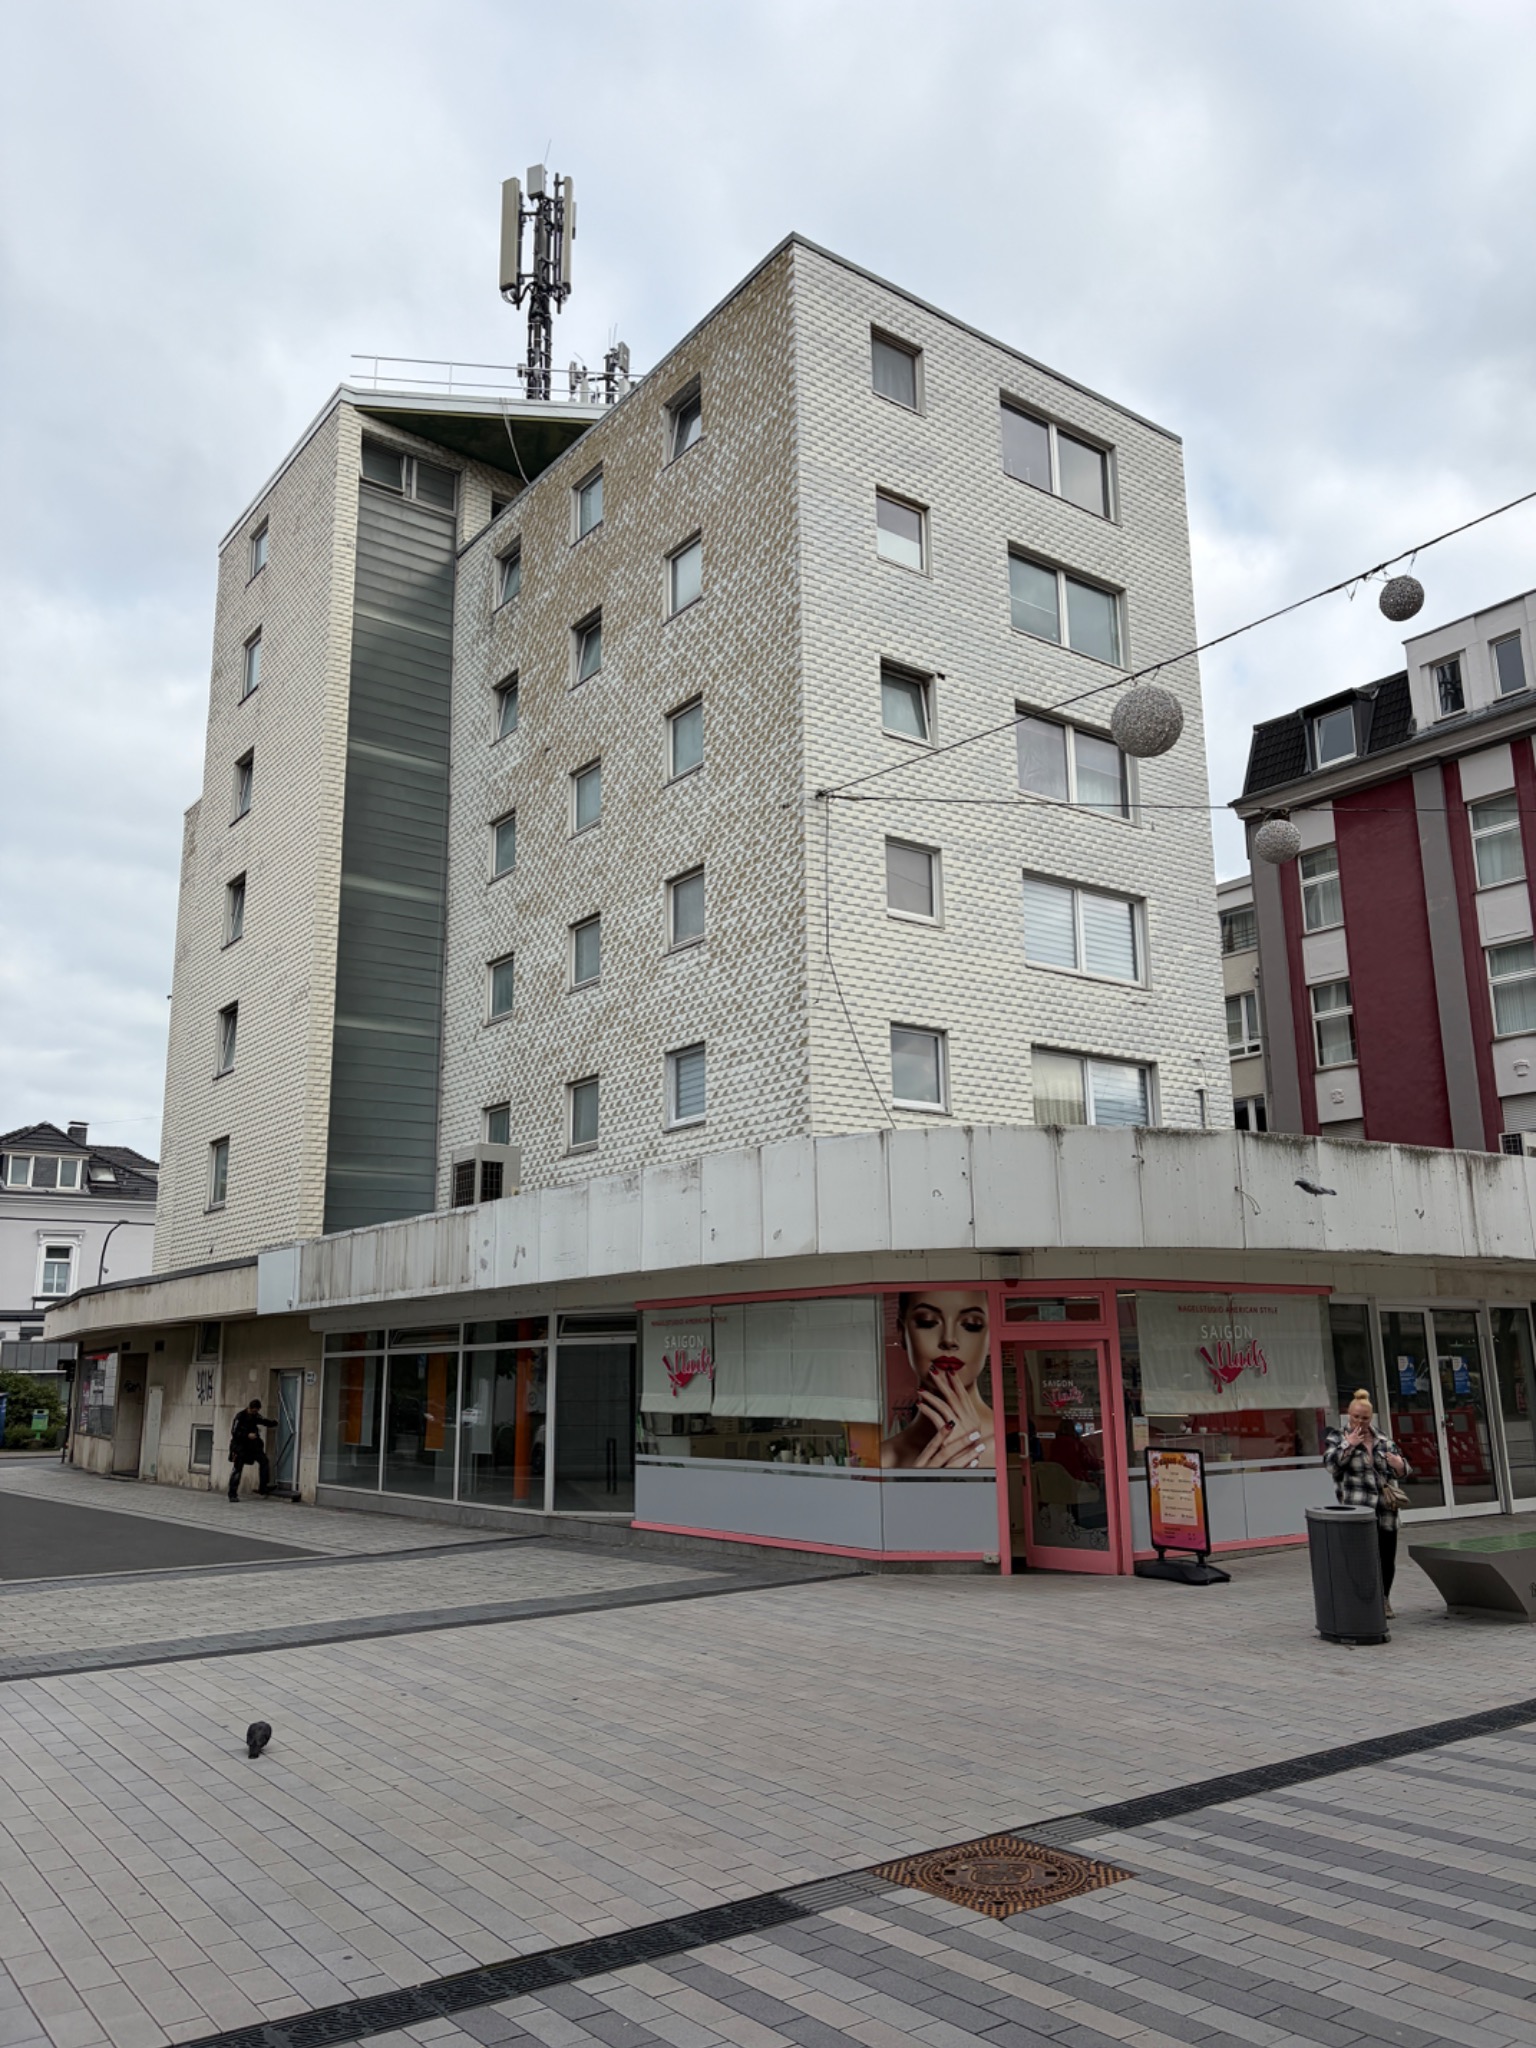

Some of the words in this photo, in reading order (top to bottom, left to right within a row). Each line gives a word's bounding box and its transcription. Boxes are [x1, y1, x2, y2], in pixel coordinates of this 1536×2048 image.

[1177, 1305, 1224, 1313] NAGELSTUDIO
[1225, 1306, 1258, 1314] AMERICAN
[1260, 1306, 1278, 1314] STYLE
[1200, 1325, 1253, 1339] SAIGON
[664, 1335, 704, 1348] SAIGON
[674, 1347, 716, 1380] Nails
[1216, 1339, 1268, 1376] Nails
[1042, 1379, 1074, 1388] SAIGON
